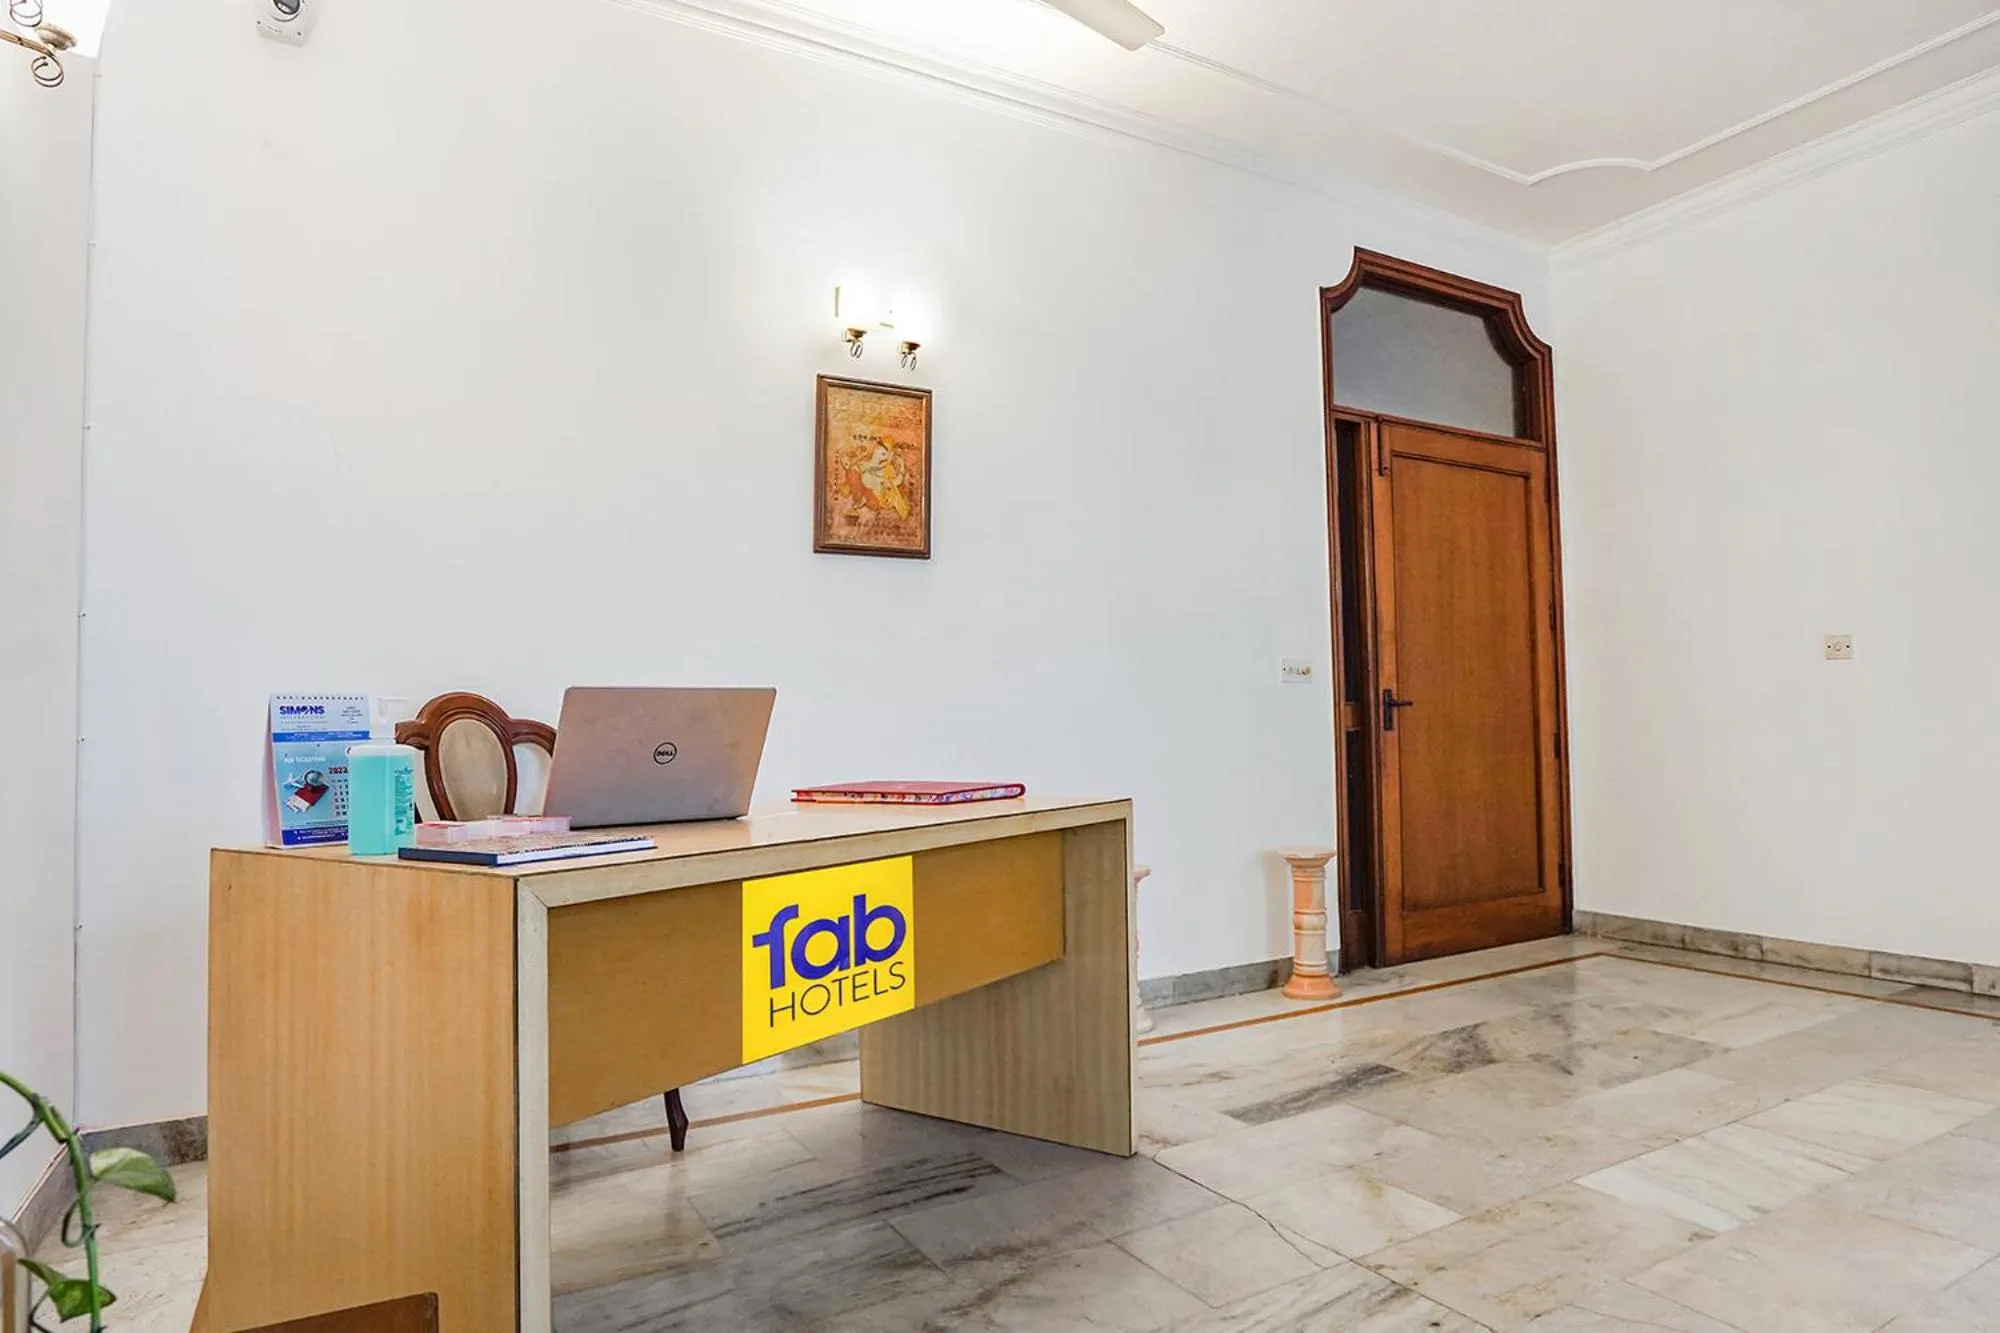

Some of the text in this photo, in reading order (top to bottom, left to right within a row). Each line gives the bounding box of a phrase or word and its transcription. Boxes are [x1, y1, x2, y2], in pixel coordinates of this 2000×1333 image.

[279, 705, 325, 715] SIMONS
[752, 894, 906, 990] fab
[770, 961, 906, 1028] HOTELS
